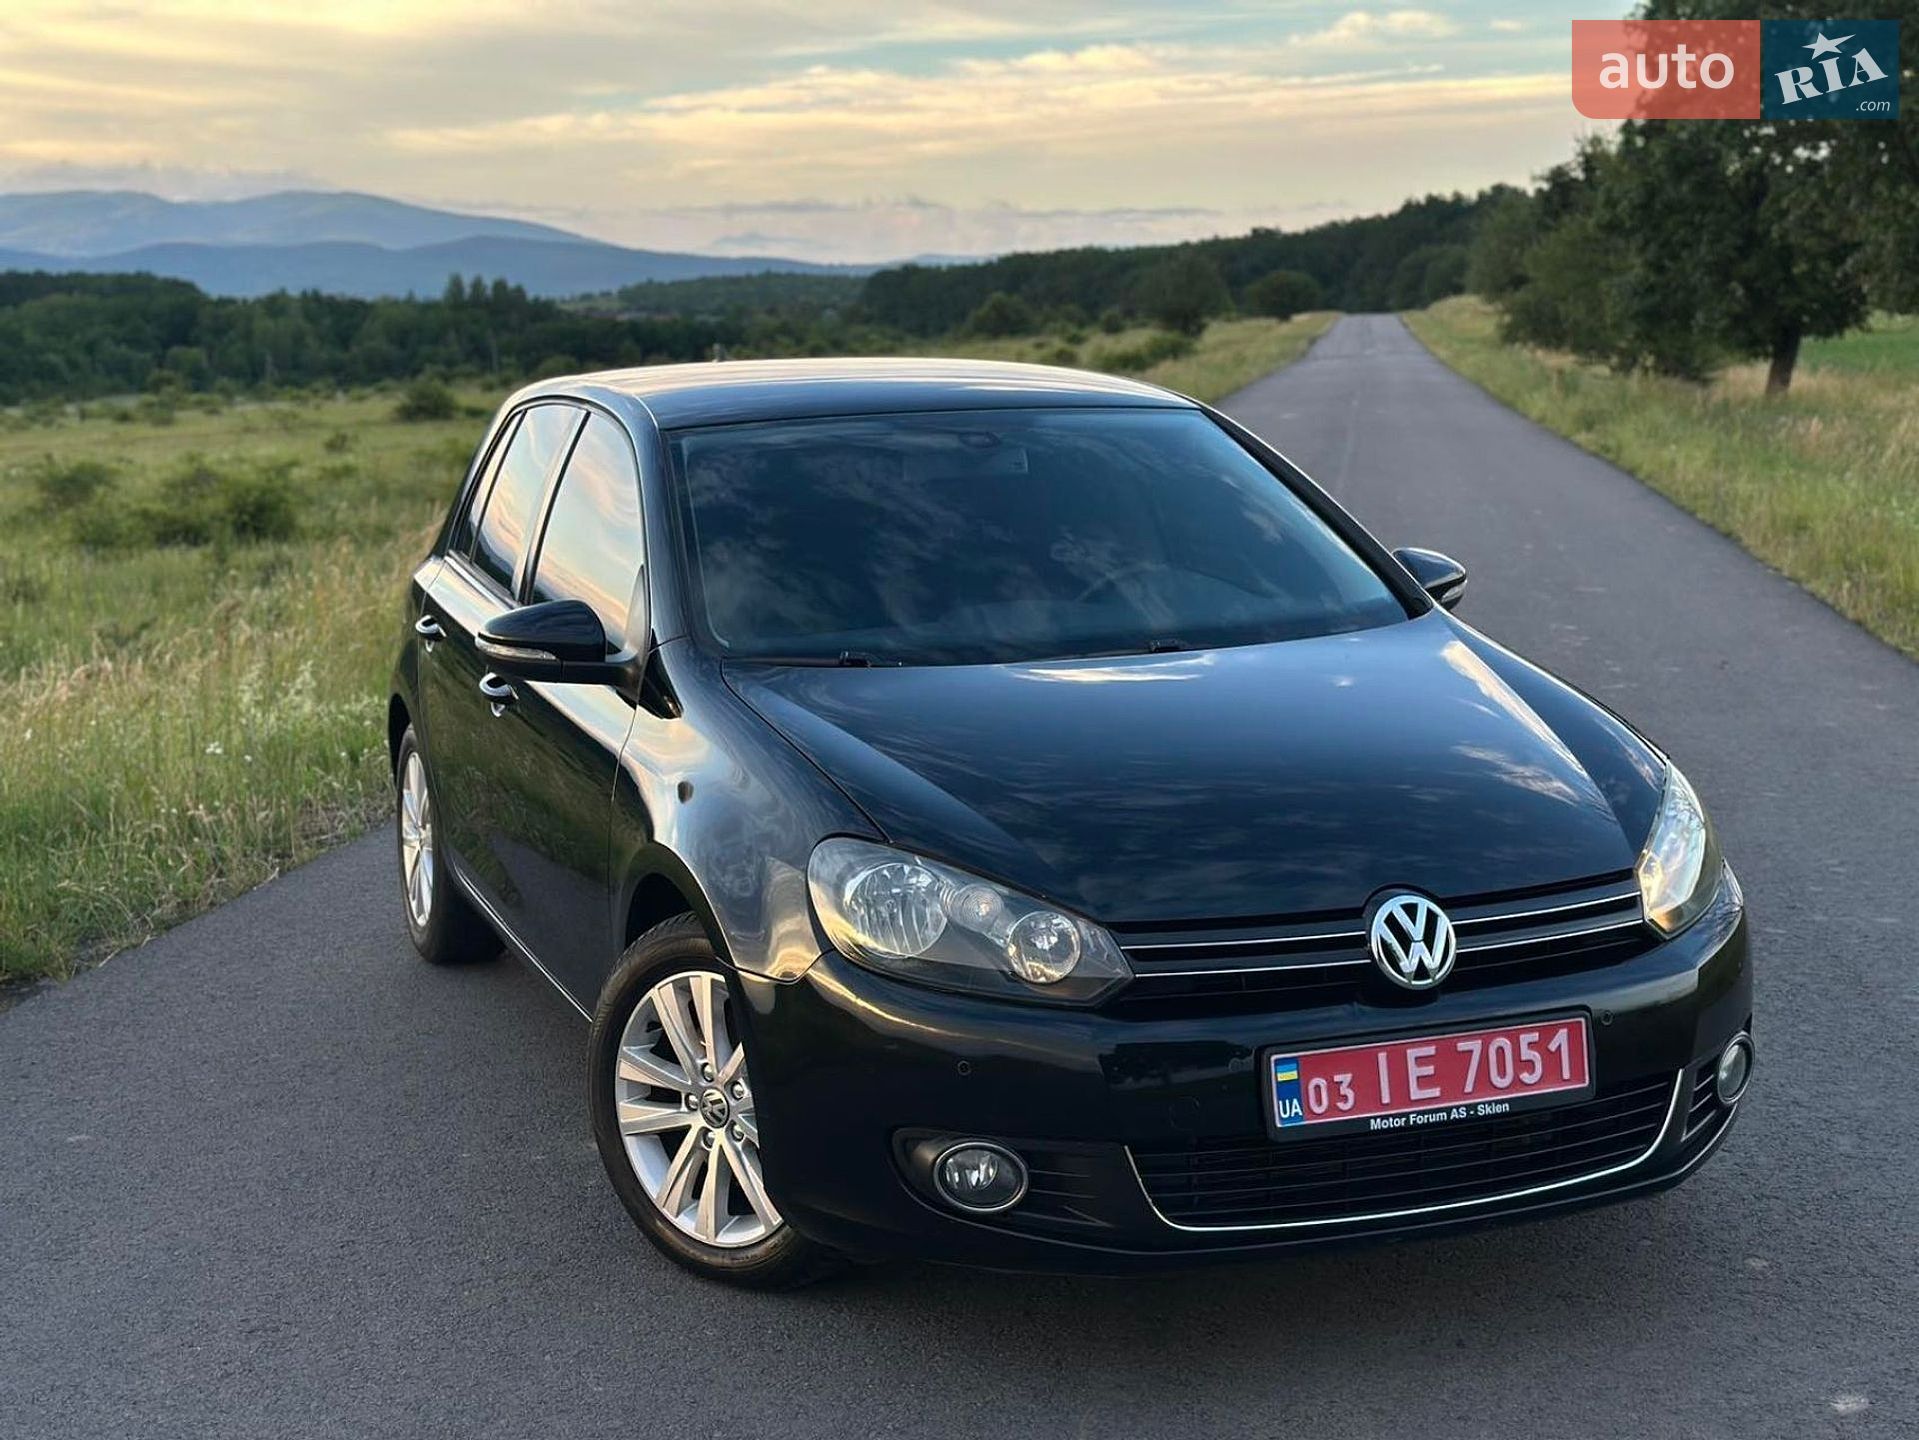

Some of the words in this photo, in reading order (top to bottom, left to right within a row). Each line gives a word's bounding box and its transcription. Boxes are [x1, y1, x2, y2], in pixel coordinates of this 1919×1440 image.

[1371, 894, 1457, 990] VW
[1308, 1073, 1355, 1115] 03
[1377, 1046, 1442, 1105] IE
[1456, 1028, 1572, 1094] 7051
[1279, 1098, 1303, 1118] UA
[1370, 1116, 1406, 1130] Motor
[1409, 1111, 1447, 1125] Forum
[1450, 1107, 1467, 1119] AS
